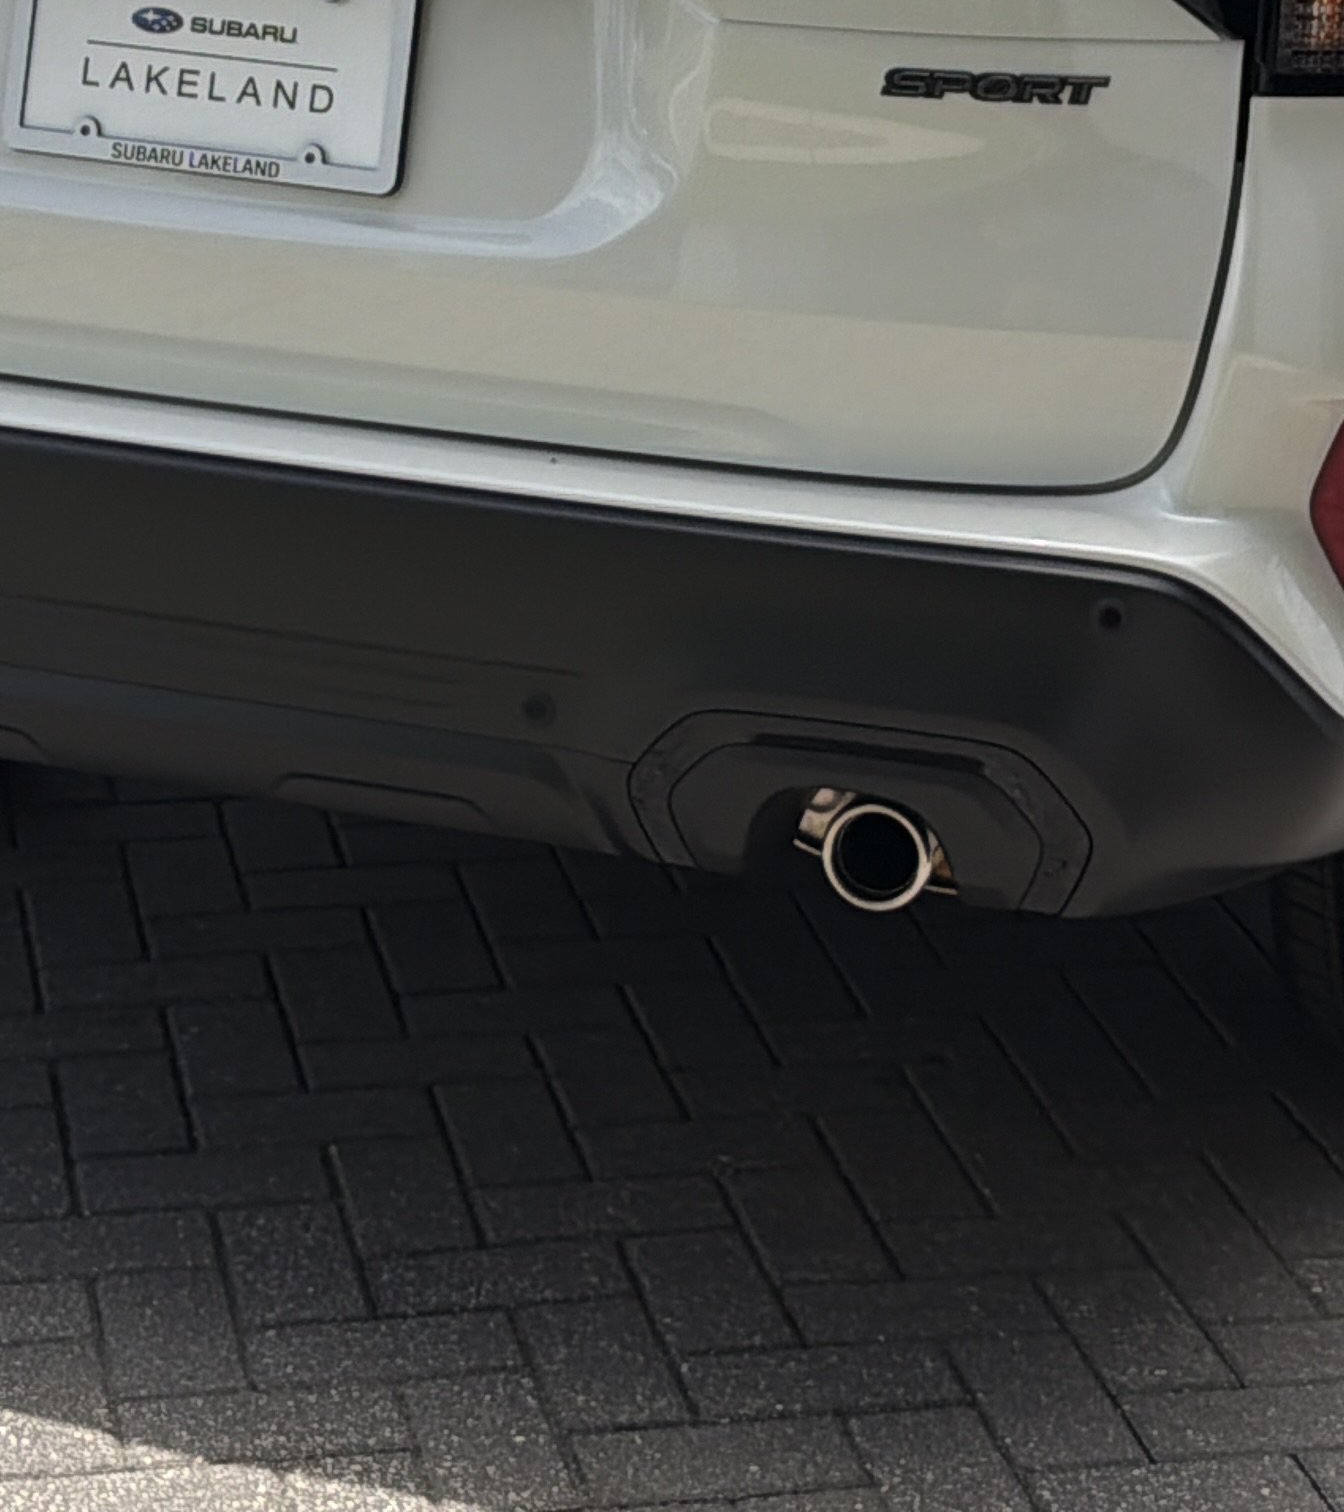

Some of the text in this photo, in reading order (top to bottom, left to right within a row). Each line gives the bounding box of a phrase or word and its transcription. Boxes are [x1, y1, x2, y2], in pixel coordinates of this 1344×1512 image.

[189, 15, 299, 45] SUBARU
[81, 56, 335, 115] LAKELAND
[880, 67, 1112, 106] SPORT
[110, 141, 281, 179] SUBARU LAKELAND
